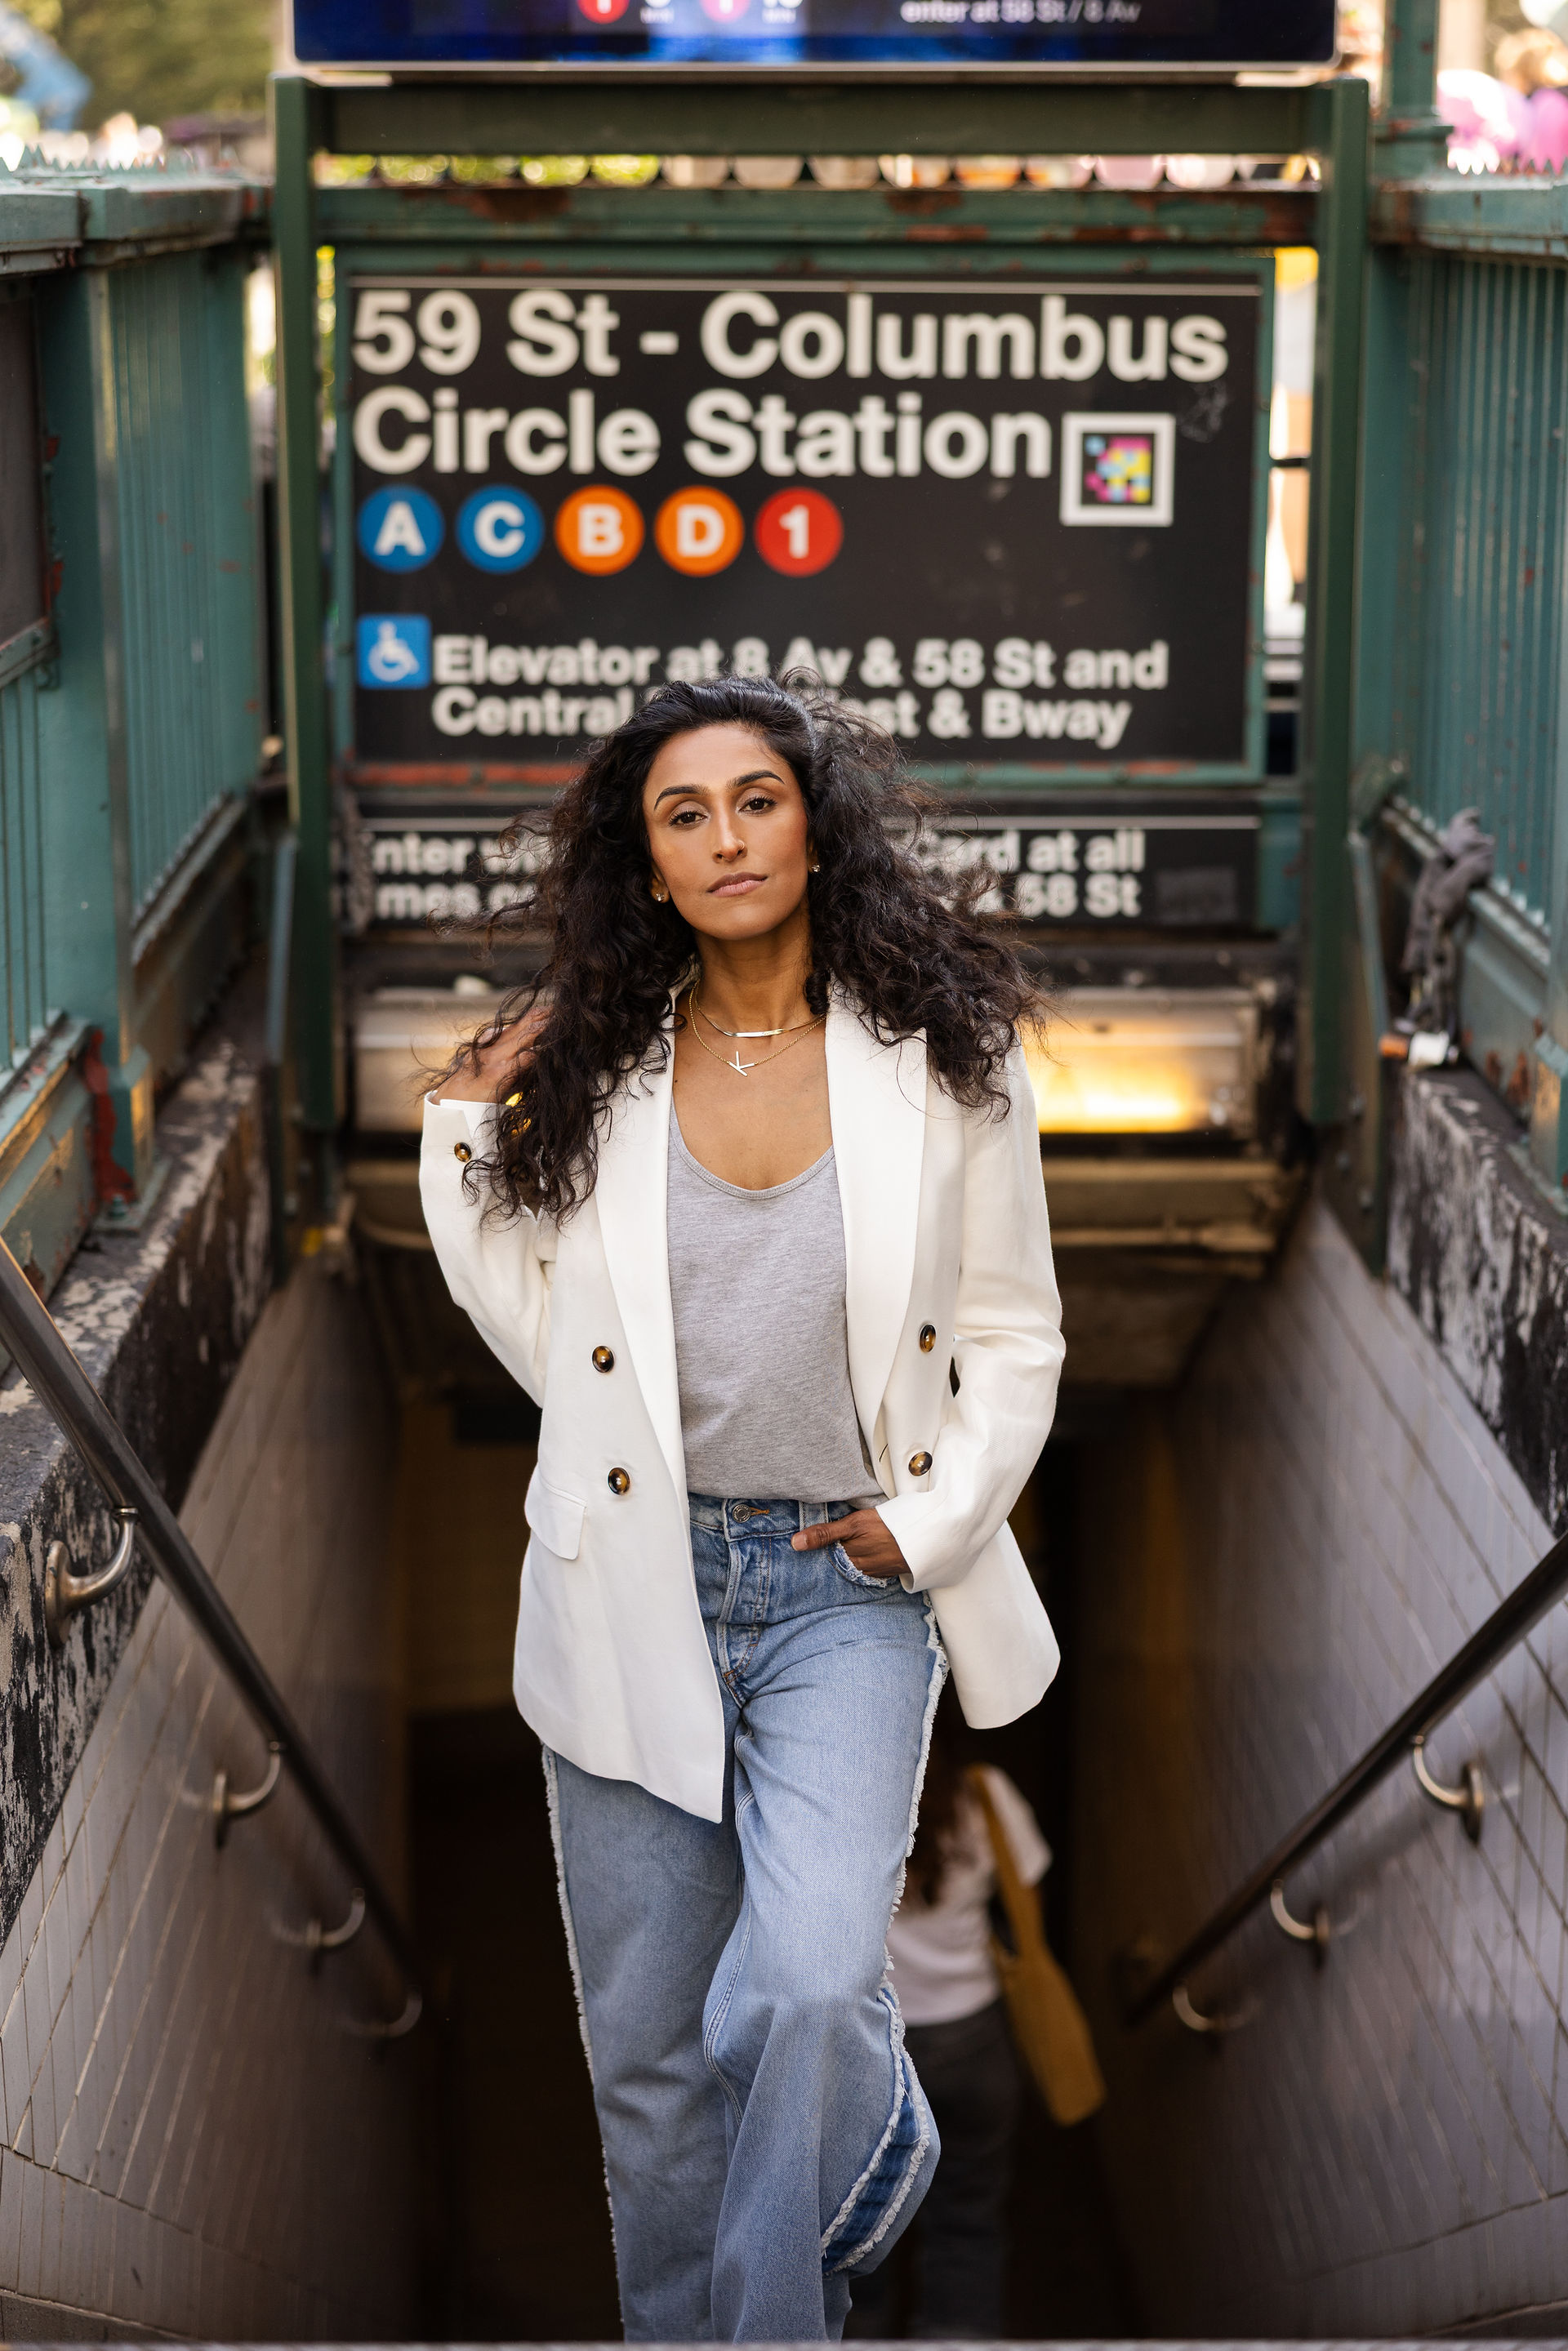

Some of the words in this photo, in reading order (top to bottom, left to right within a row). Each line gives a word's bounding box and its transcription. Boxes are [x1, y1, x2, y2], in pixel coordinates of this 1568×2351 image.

[354, 290, 480, 375] 59
[507, 289, 620, 376] St
[702, 291, 1227, 381] Columbus
[354, 386, 660, 475] Circle
[684, 389, 1052, 477] Station
[374, 501, 425, 556] A
[474, 501, 525, 558] C
[577, 503, 624, 557] B
[676, 503, 725, 558] D
[781, 505, 809, 559] 1
[434, 635, 660, 685] Elevator
[666, 639, 723, 683] at
[733, 637, 770, 678] 8
[778, 637, 852, 687] Av
[860, 637, 902, 688] &
[912, 638, 985, 688] 58
[992, 638, 1056, 688] St
[1063, 640, 1169, 689] and
[432, 686, 634, 736] Central
[928, 688, 972, 738] &
[982, 689, 1132, 750] Bway
[361, 833, 477, 875] nter
[1027, 831, 1079, 872] at
[1085, 829, 1146, 872] all
[1085, 872, 1140, 917] St
